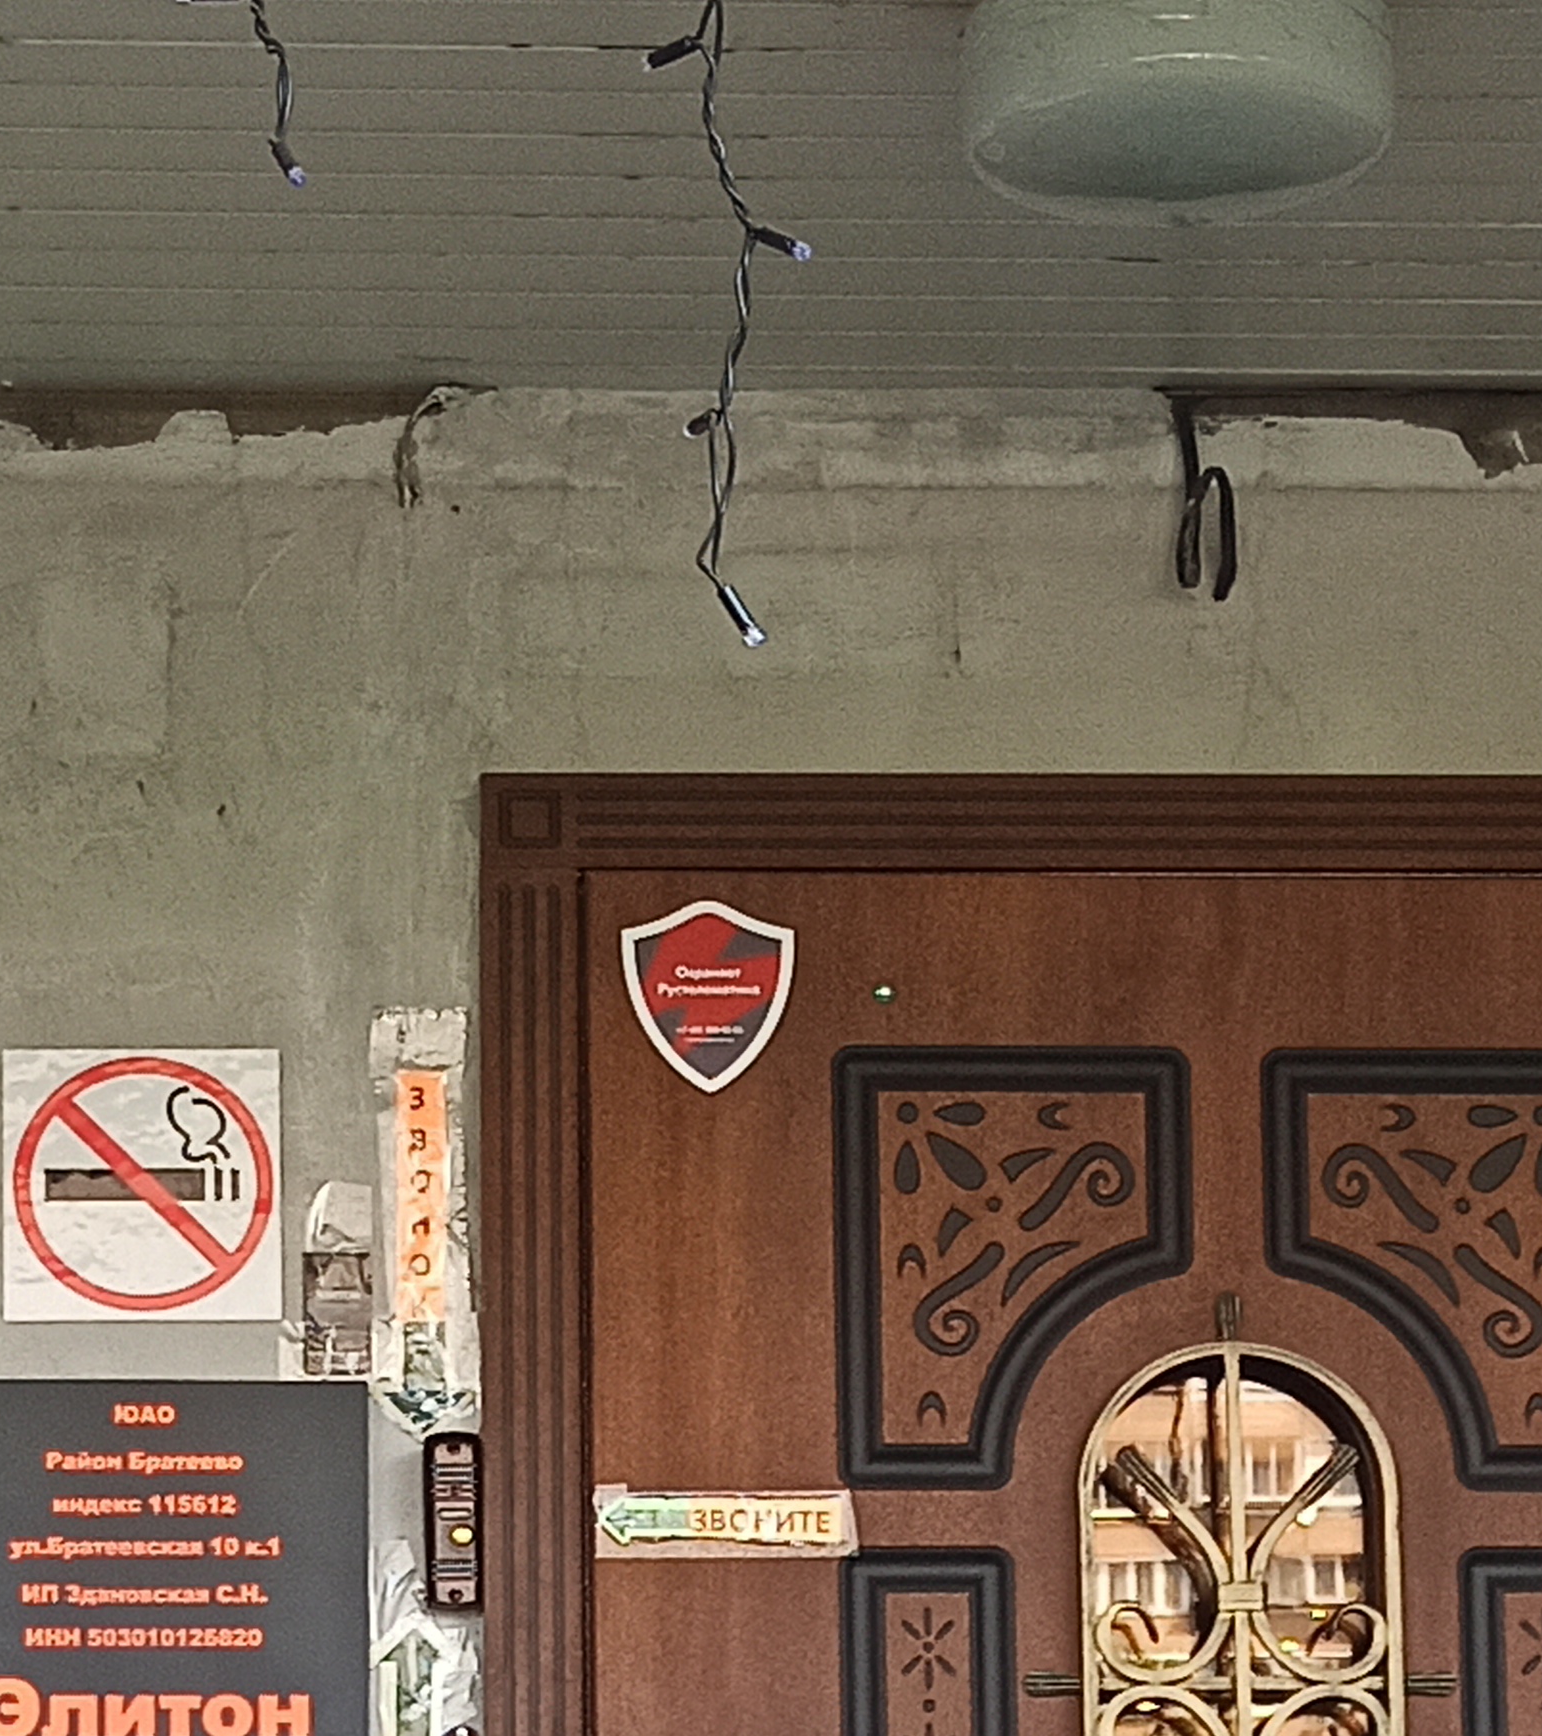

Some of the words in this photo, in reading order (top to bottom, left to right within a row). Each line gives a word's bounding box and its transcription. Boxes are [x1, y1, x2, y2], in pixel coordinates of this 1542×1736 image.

[113, 1404, 175, 1424] ЮАО
[45, 1451, 122, 1471] Район
[127, 1451, 244, 1475] Братеево
[52, 1497, 143, 1515] индекс
[148, 1494, 237, 1515] 115612
[692, 1508, 830, 1533] ЗВОНИТЕ
[209, 1536, 239, 1556] 10
[244, 1536, 280, 1556] к.1
[21, 1583, 58, 1604] ИП
[215, 1583, 269, 1604] С.Н.
[24, 1627, 81, 1647] ИНН
